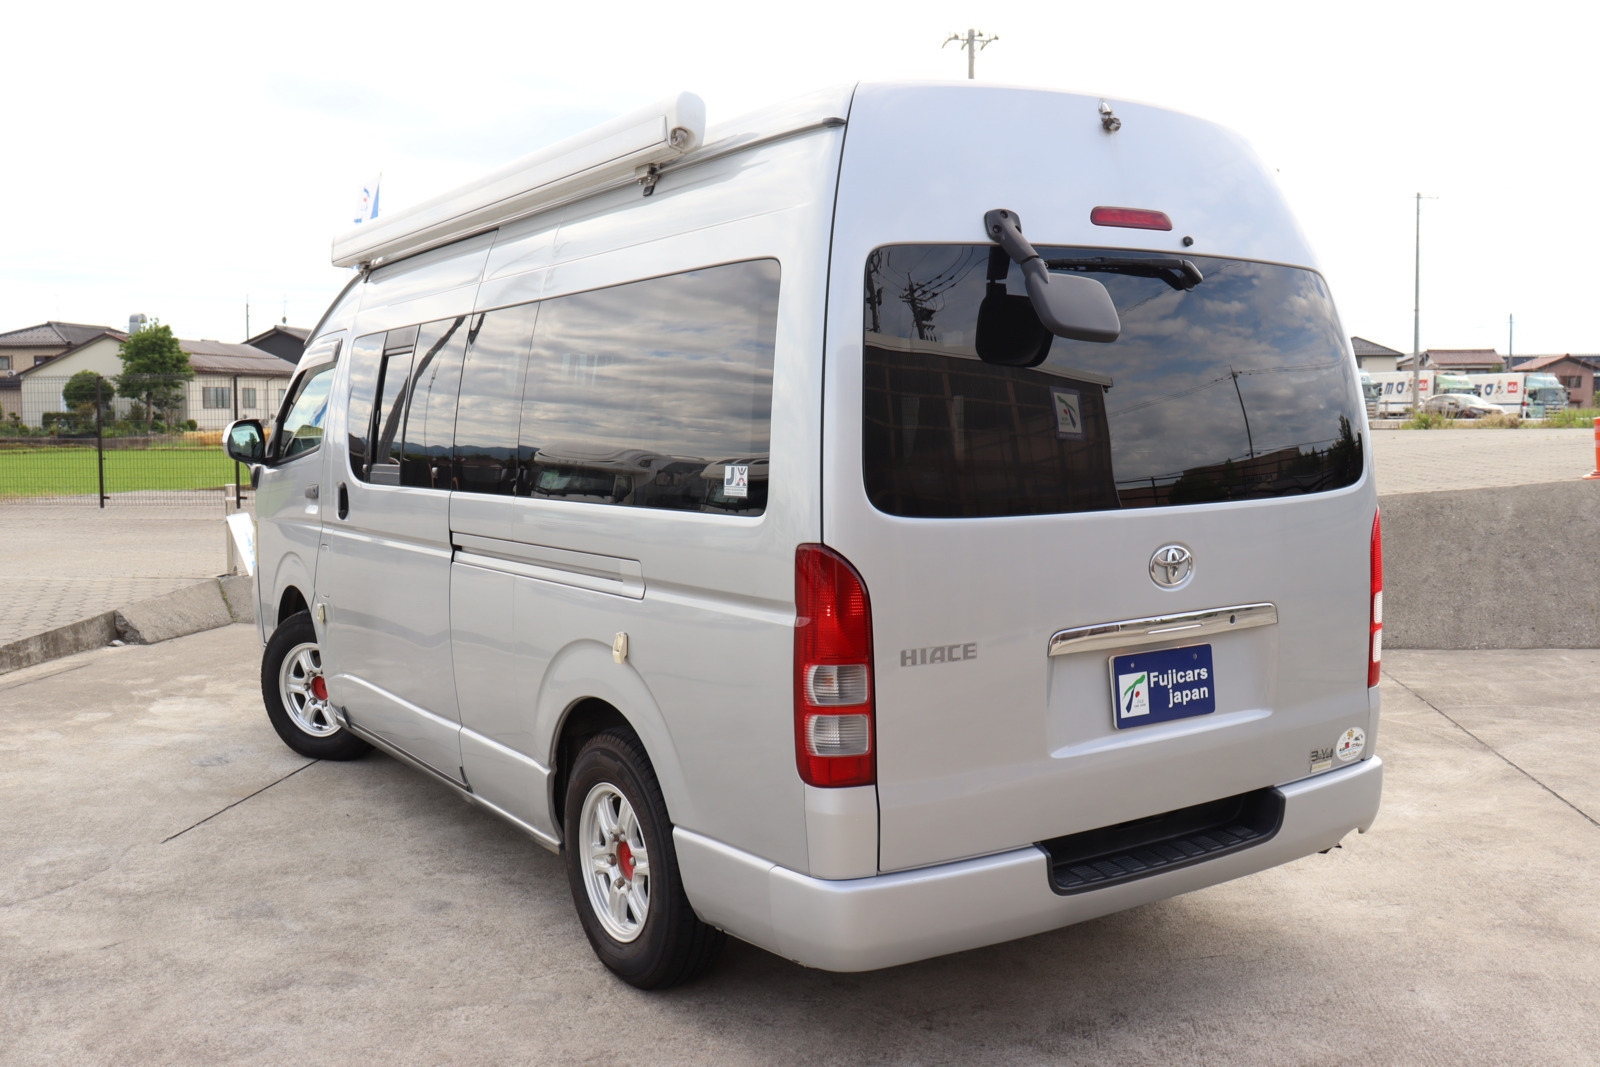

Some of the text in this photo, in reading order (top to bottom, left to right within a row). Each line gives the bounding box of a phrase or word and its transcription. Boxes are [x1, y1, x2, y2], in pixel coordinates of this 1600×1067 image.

[900, 642, 977, 667] HIACE
[1149, 667, 1208, 689] Fujicars
[1168, 686, 1209, 708] japan
